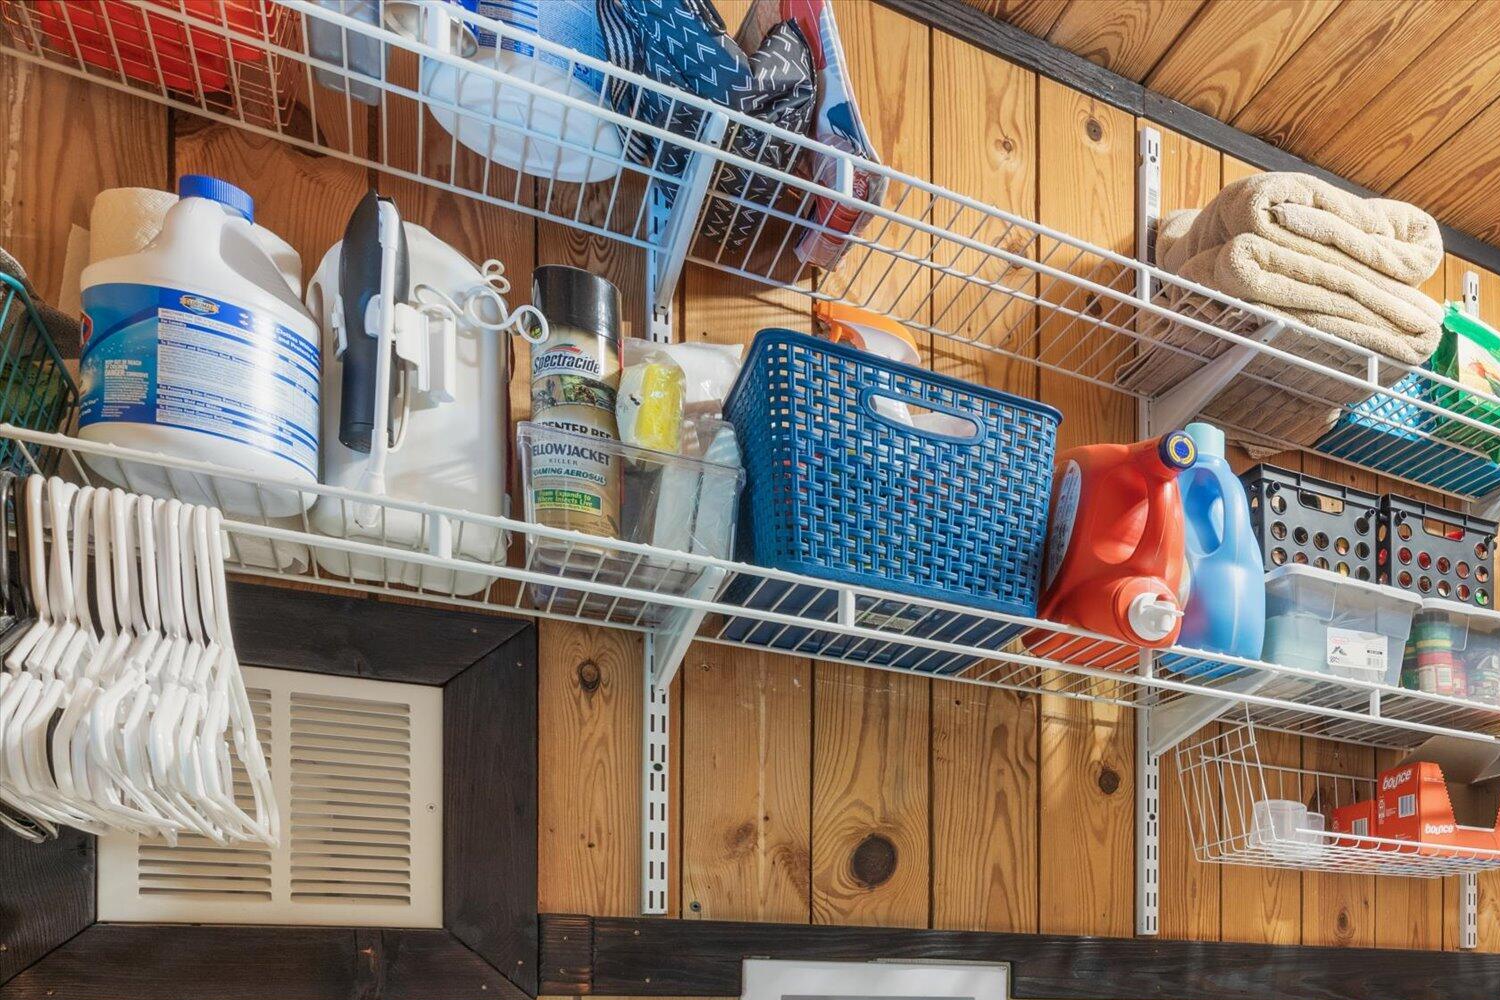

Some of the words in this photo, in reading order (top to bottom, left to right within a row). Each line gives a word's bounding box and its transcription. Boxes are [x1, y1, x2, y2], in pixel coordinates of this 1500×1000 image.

[533, 352, 600, 375] Spectracide
[532, 443, 611, 467] ELLOWJACKET
[1382, 768, 1413, 791] bounce
[1424, 823, 1455, 834] bounce
